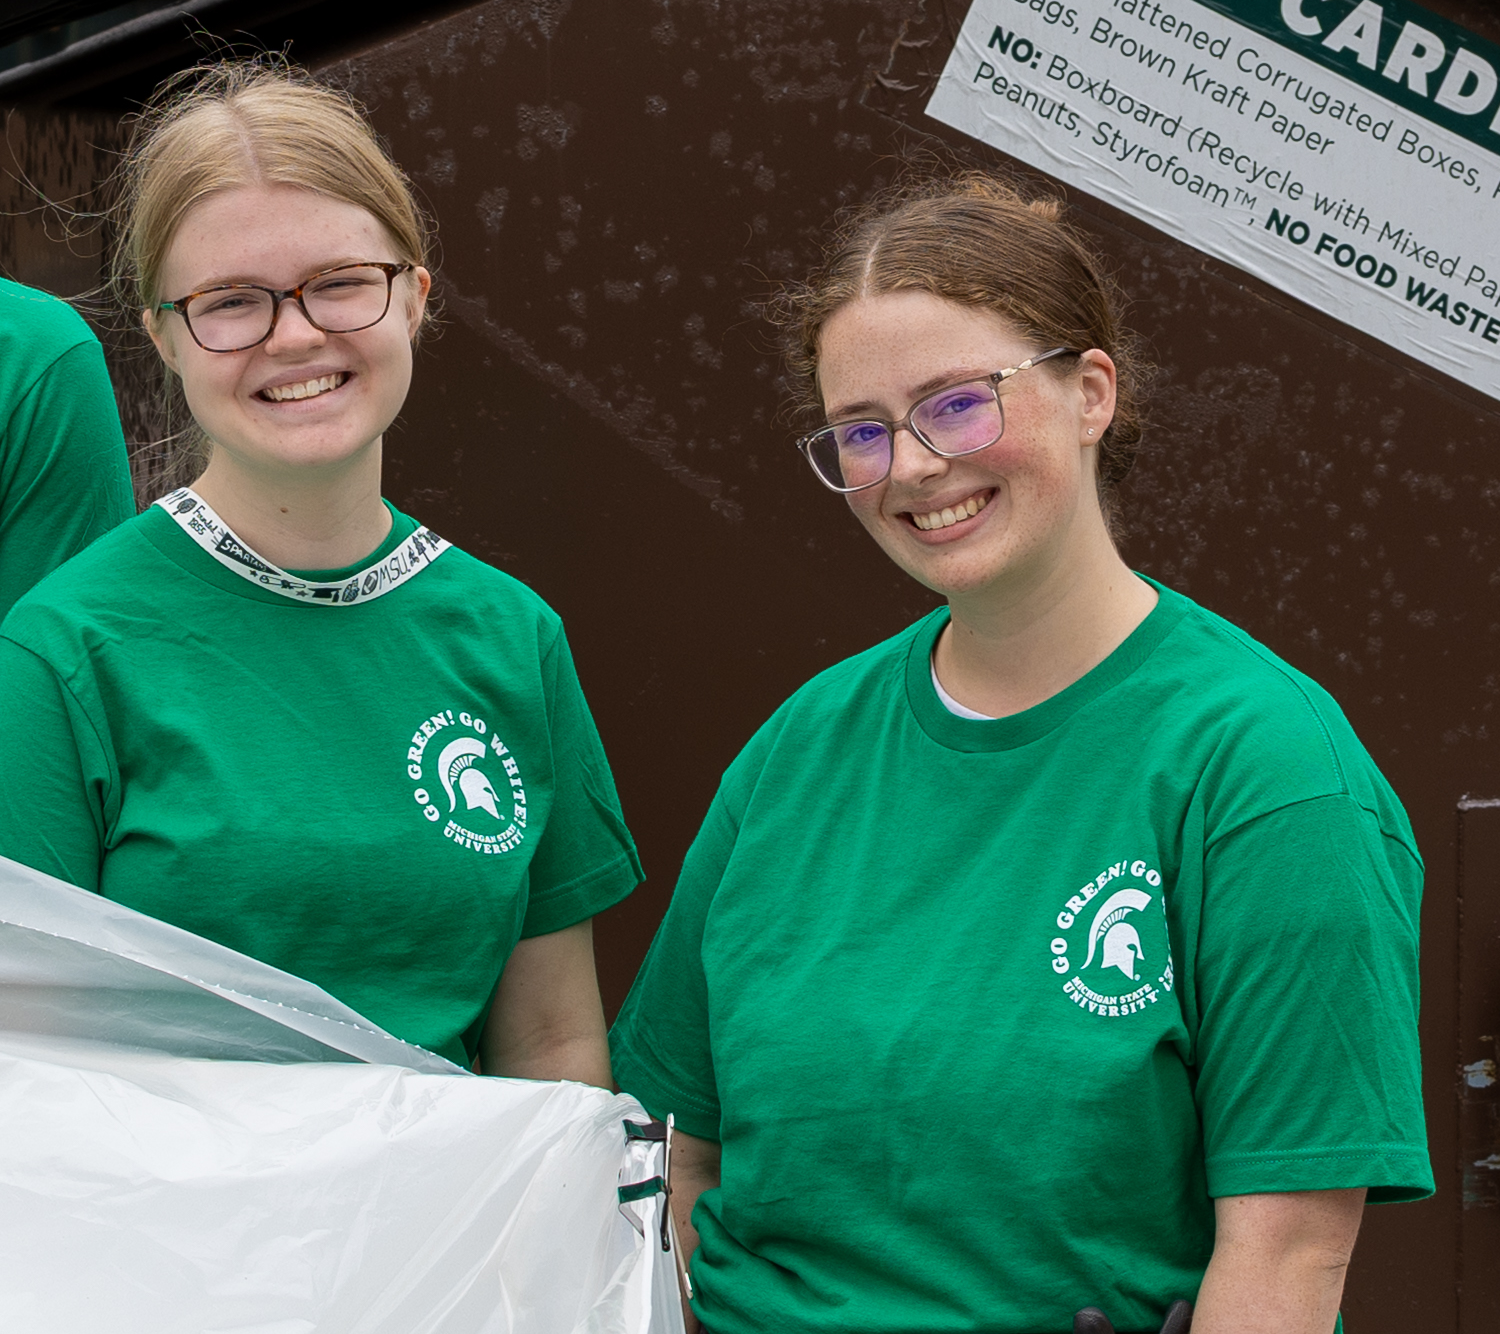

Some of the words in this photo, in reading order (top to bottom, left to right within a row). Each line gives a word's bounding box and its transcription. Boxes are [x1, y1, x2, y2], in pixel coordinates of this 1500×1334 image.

[1089, 16, 1176, 77] Brown
[1181, 63, 1249, 114] Kraft
[1254, 99, 1334, 154] Paper
[1236, 47, 1393, 141] Corrugated
[1396, 128, 1480, 192] Boxes,
[987, 25, 1042, 69] NO:
[1045, 54, 1182, 137] Boxboard
[1187, 126, 1303, 200] (Recycle
[1313, 192, 1369, 234] with
[1377, 220, 1460, 277] Mixed
[973, 60, 1080, 137] Peanuts,
[1264, 207, 1310, 245] NO
[1313, 232, 1397, 288] FOOD
[187, 517, 206, 536] 1855
[220, 539, 267, 572] SPARTANS
[459, 711, 487, 734] GO
[407, 709, 455, 781] GREEN!
[490, 733, 527, 828] WHITE!
[414, 788, 440, 822] GO
[447, 820, 497, 843] MICHIGAN
[1130, 860, 1161, 887] GO
[1056, 860, 1128, 930] GREEN!
[1050, 937, 1070, 974] GO
[1062, 981, 1159, 1017] UNIVERSITY
[1071, 976, 1118, 1005] MICHIGAN
[1119, 983, 1152, 1004] STATE
